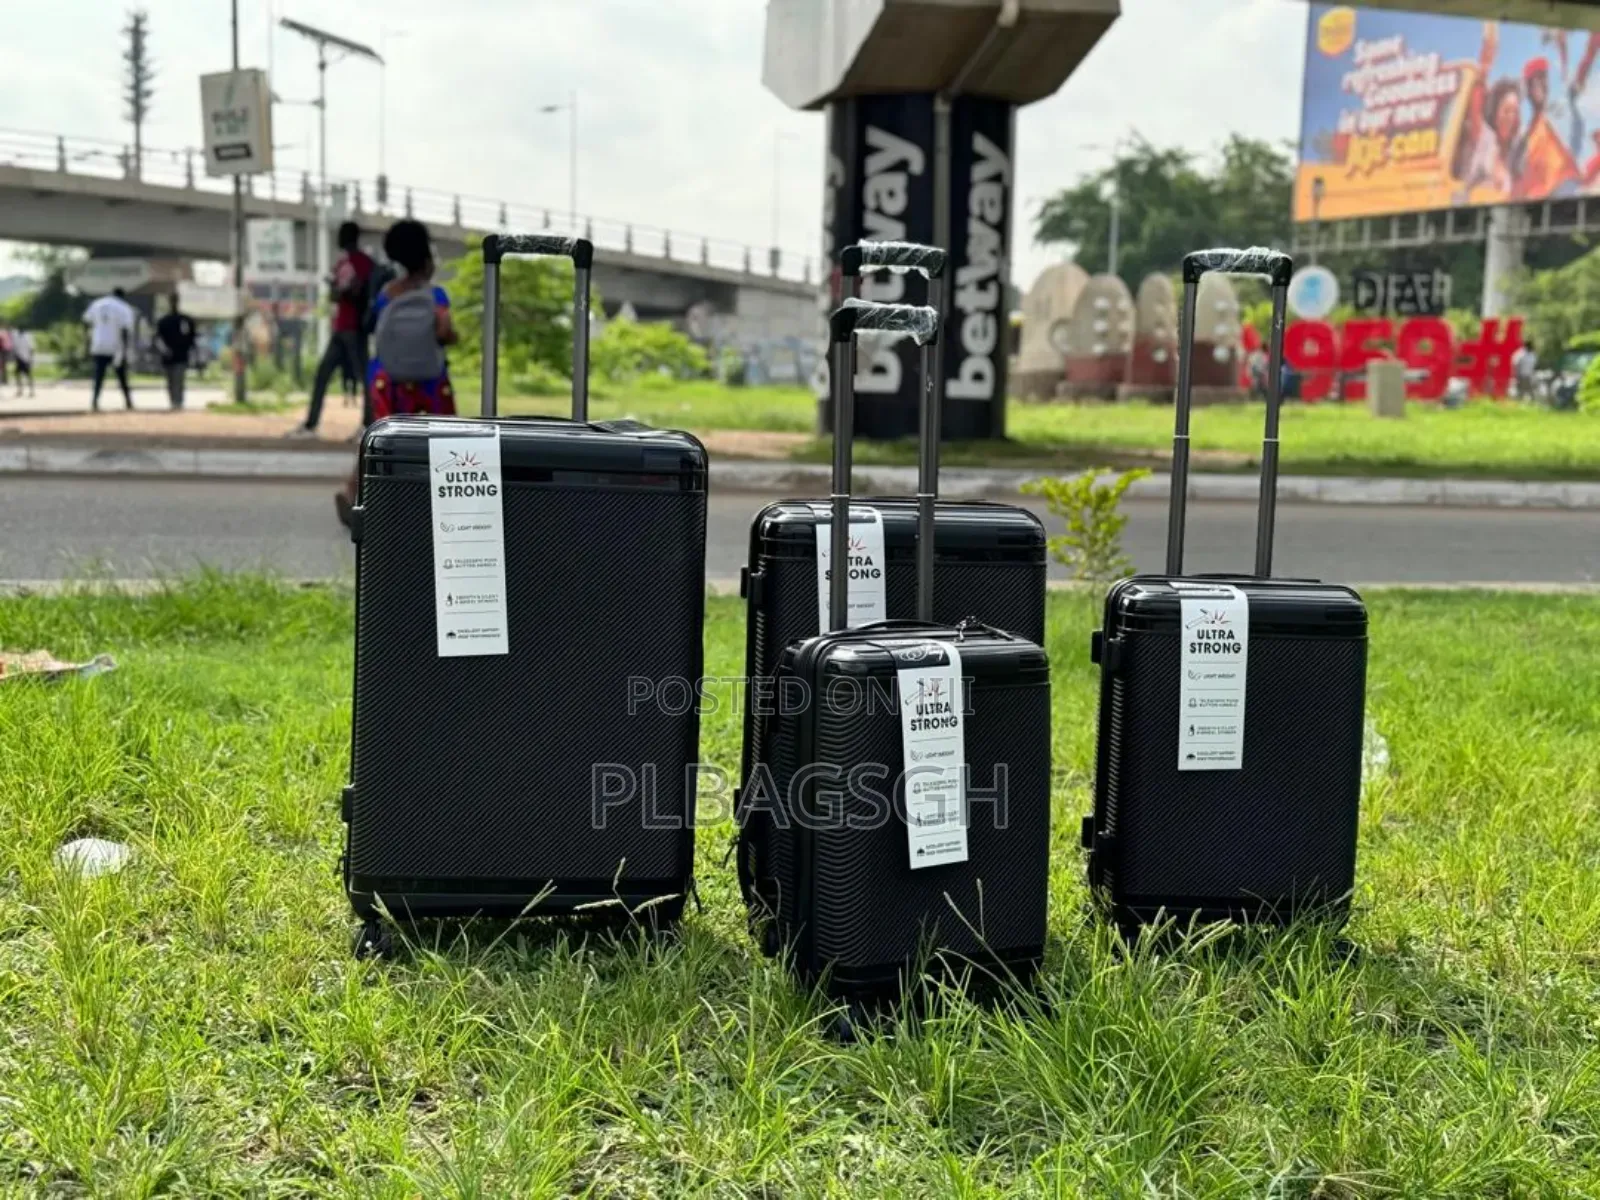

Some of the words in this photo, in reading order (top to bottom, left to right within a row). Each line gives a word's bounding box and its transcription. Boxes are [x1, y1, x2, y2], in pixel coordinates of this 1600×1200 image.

[945, 131, 1010, 400] betway
[445, 471, 489, 483] ULTRA
[438, 484, 498, 498] STRONG
[847, 556, 873, 566] TRA
[825, 568, 881, 580] SONG
[1197, 629, 1235, 640] ULTRA
[1189, 642, 1242, 654] STRONG
[916, 701, 952, 716] ULTRA
[910, 716, 958, 732] STRONG
